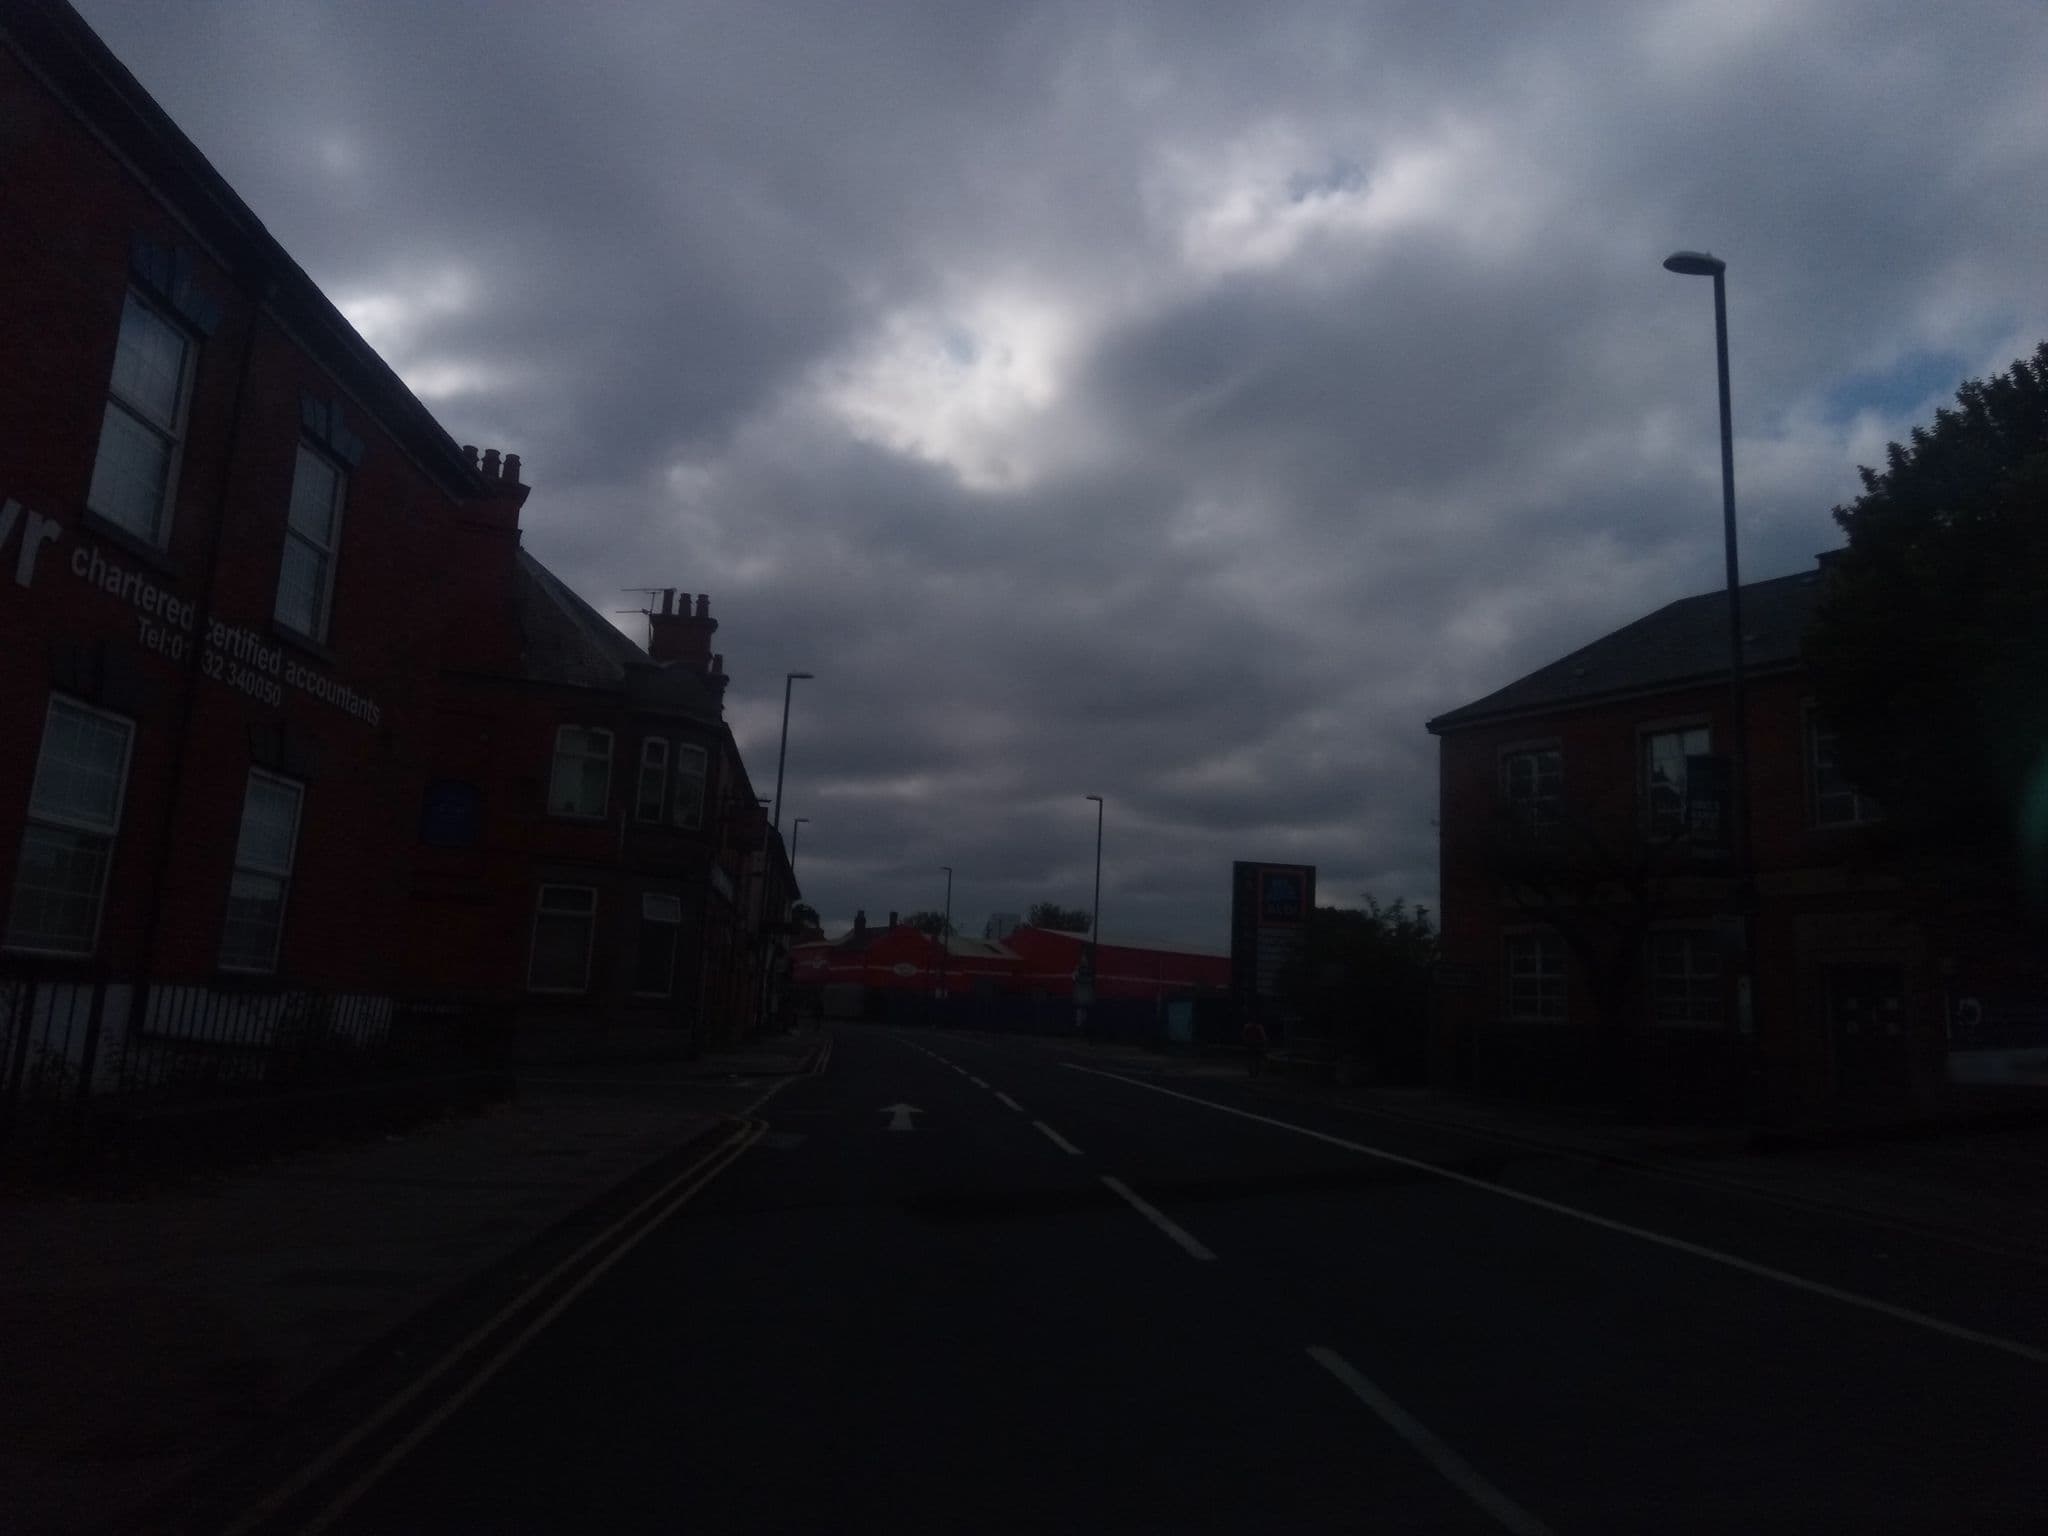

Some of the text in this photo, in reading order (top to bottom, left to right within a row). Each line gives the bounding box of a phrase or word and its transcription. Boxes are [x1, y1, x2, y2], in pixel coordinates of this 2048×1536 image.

[72, 544, 196, 631] chartered
[286, 659, 382, 727] accountants
[138, 616, 281, 707] Tel:0132 340050
